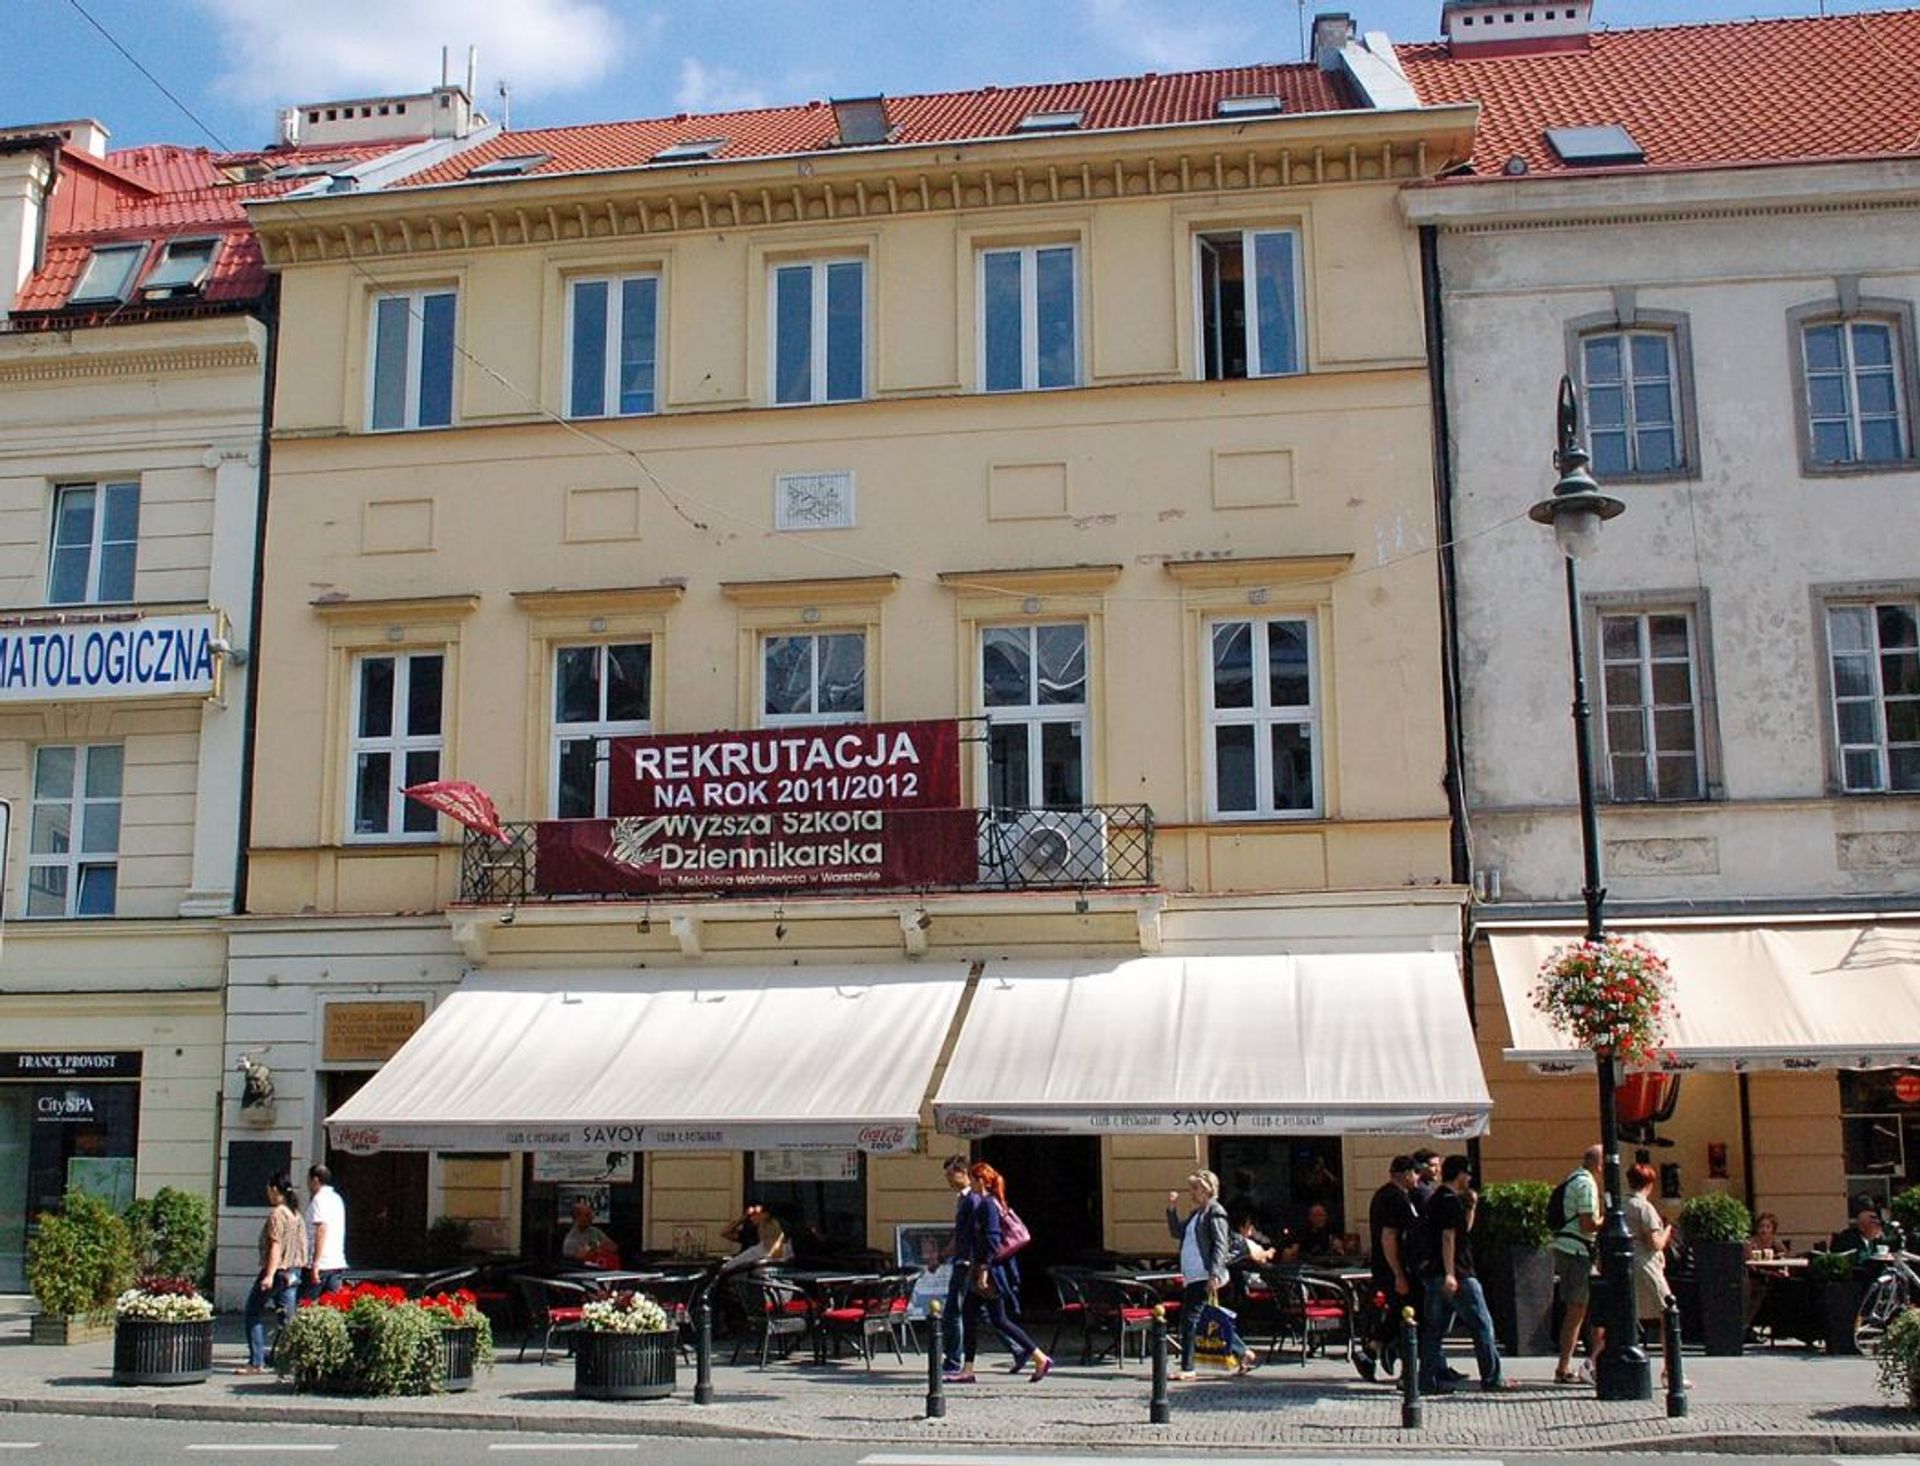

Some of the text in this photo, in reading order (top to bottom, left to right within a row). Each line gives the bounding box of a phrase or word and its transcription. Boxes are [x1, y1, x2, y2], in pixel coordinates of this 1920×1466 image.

[635, 731, 920, 780] REKRUTACJA
[654, 772, 919, 808] NA ROK 2011/2012
[660, 839, 883, 870] Dziennikarska
[18, 1055, 118, 1068] FRANCK PROVOST
[1172, 1110, 1242, 1127] SAVOY
[583, 1126, 645, 1143] SAVOY
